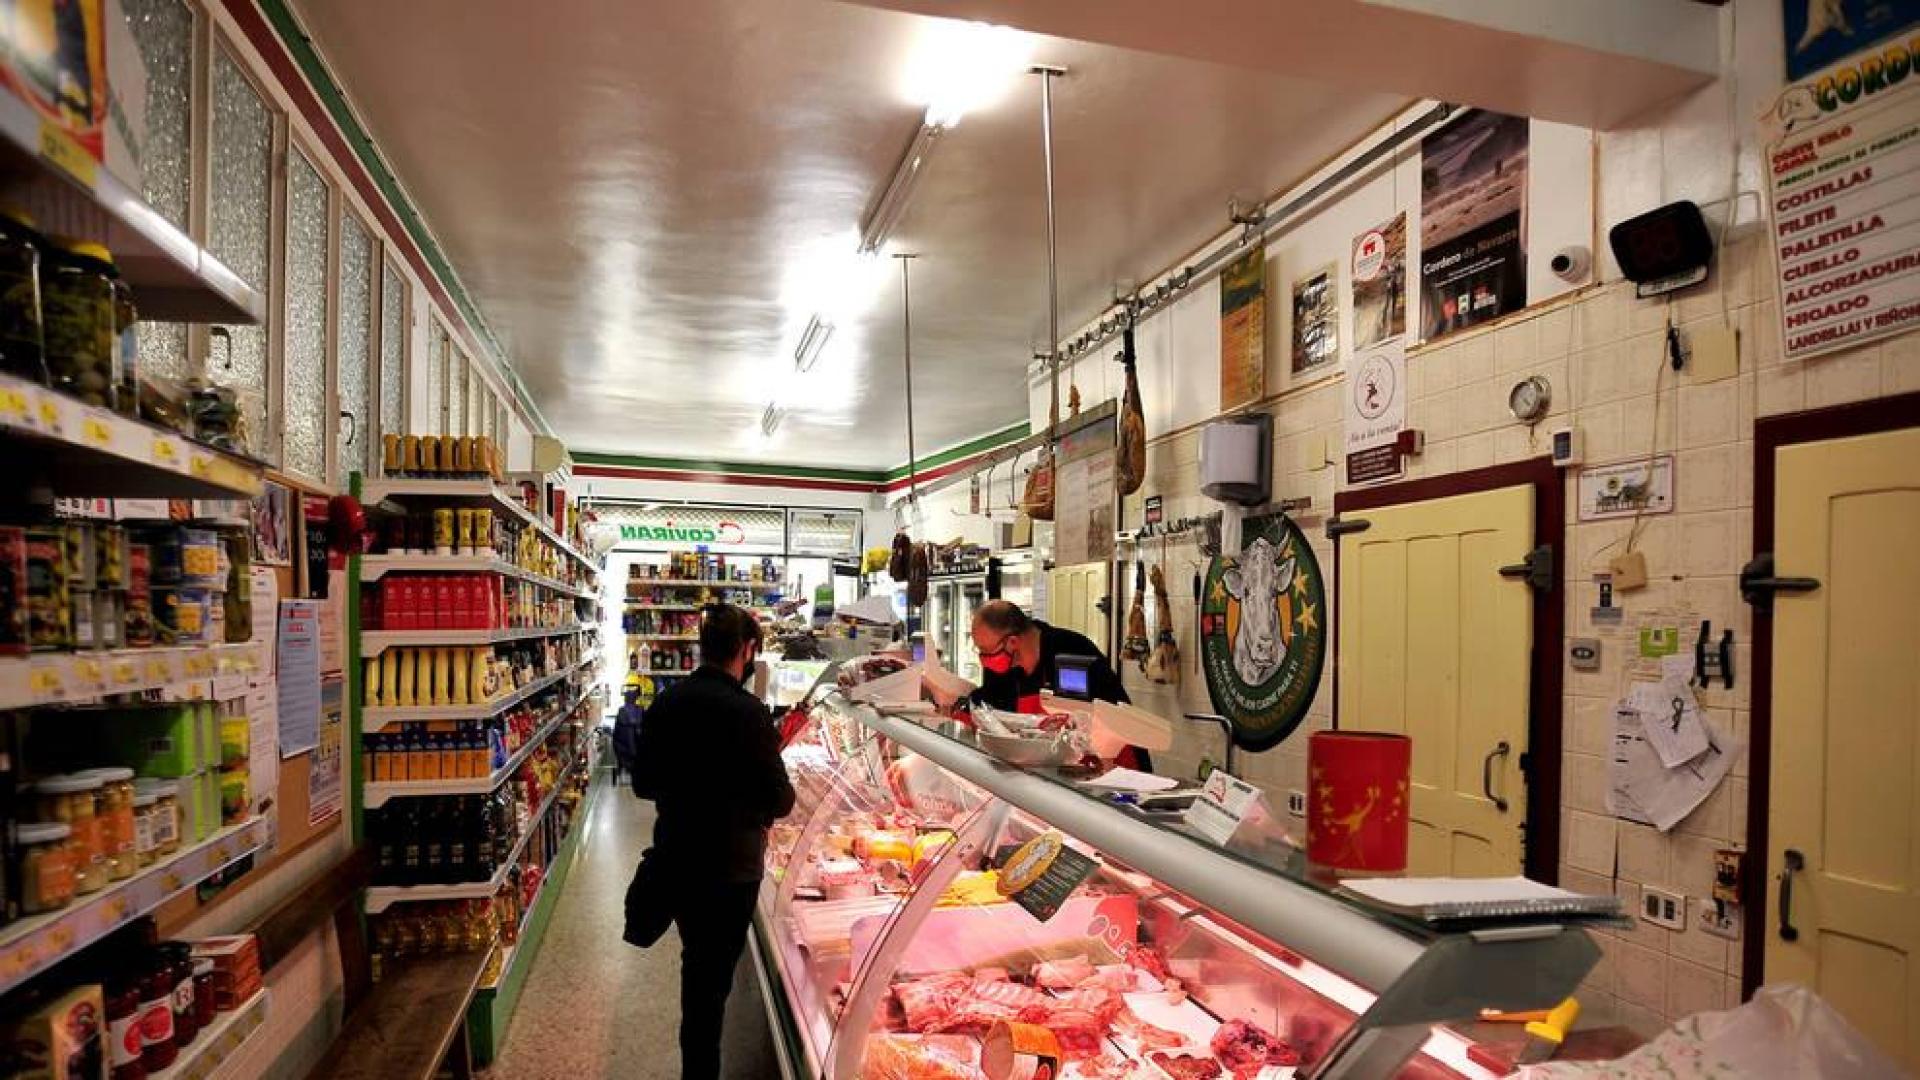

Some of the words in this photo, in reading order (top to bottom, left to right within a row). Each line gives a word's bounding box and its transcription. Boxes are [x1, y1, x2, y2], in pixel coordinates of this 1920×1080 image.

[1776, 167, 1872, 212] COSTILLAS
[1779, 205, 1836, 236] FILETE
[1781, 214, 1884, 260] PALETILLA
[1422, 253, 1461, 276] Cordero
[1783, 248, 1860, 282] CUELLO
[1786, 294, 1870, 329] HIGADO
